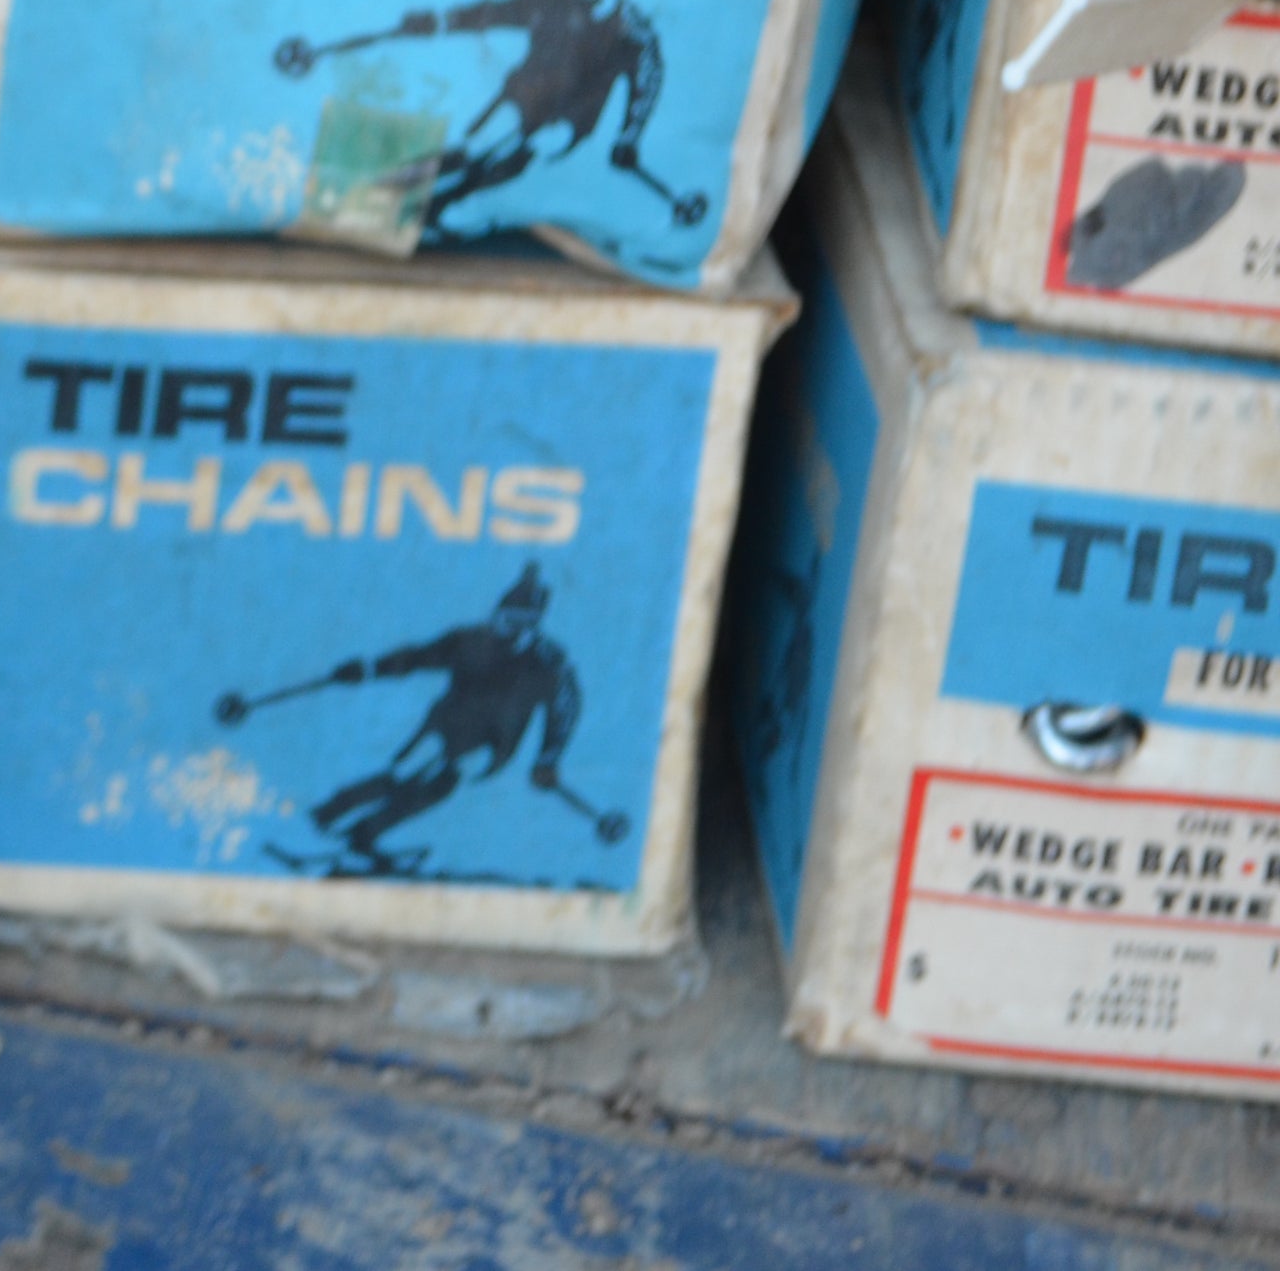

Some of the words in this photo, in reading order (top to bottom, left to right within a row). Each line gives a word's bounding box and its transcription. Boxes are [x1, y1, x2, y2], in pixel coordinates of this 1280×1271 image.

[23, 357, 359, 448] TIRE
[7, 447, 589, 546] CHAINS
[1194, 647, 1274, 693] FOR
[970, 819, 1122, 875] WEDGE
[1139, 840, 1227, 880] BAR
[969, 867, 1126, 910] AUTO
[1153, 887, 1276, 922] TIRE
